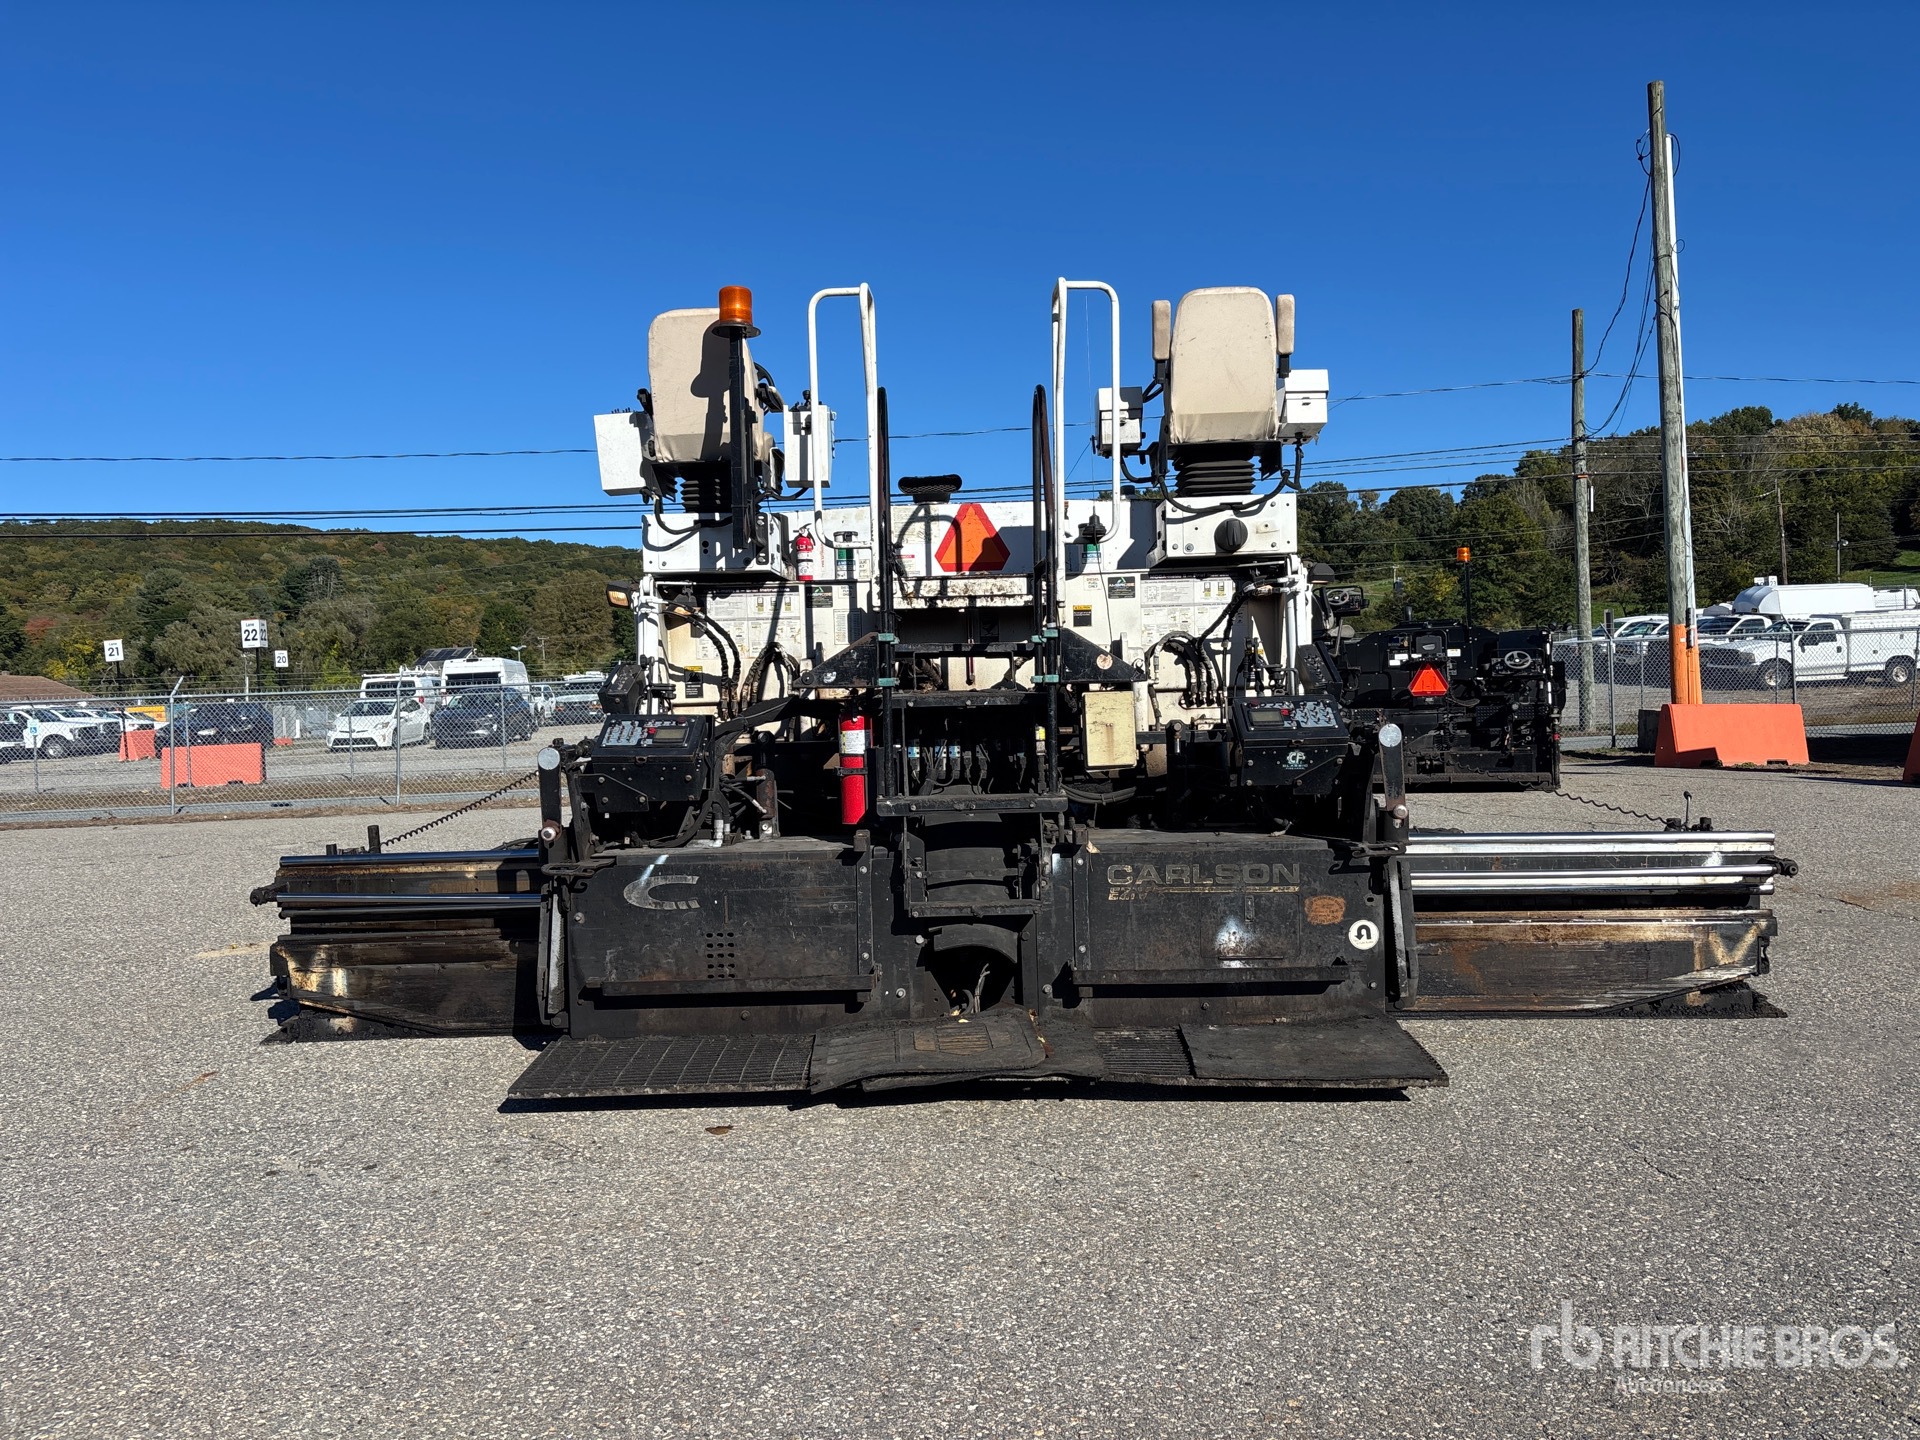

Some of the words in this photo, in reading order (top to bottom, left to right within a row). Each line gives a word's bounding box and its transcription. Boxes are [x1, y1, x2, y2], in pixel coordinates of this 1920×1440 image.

[243, 629, 259, 642] 22
[260, 628, 267, 641] 22
[107, 646, 120, 657] 21
[276, 655, 287, 664] 20
[1107, 863, 1301, 885] CARLSON
